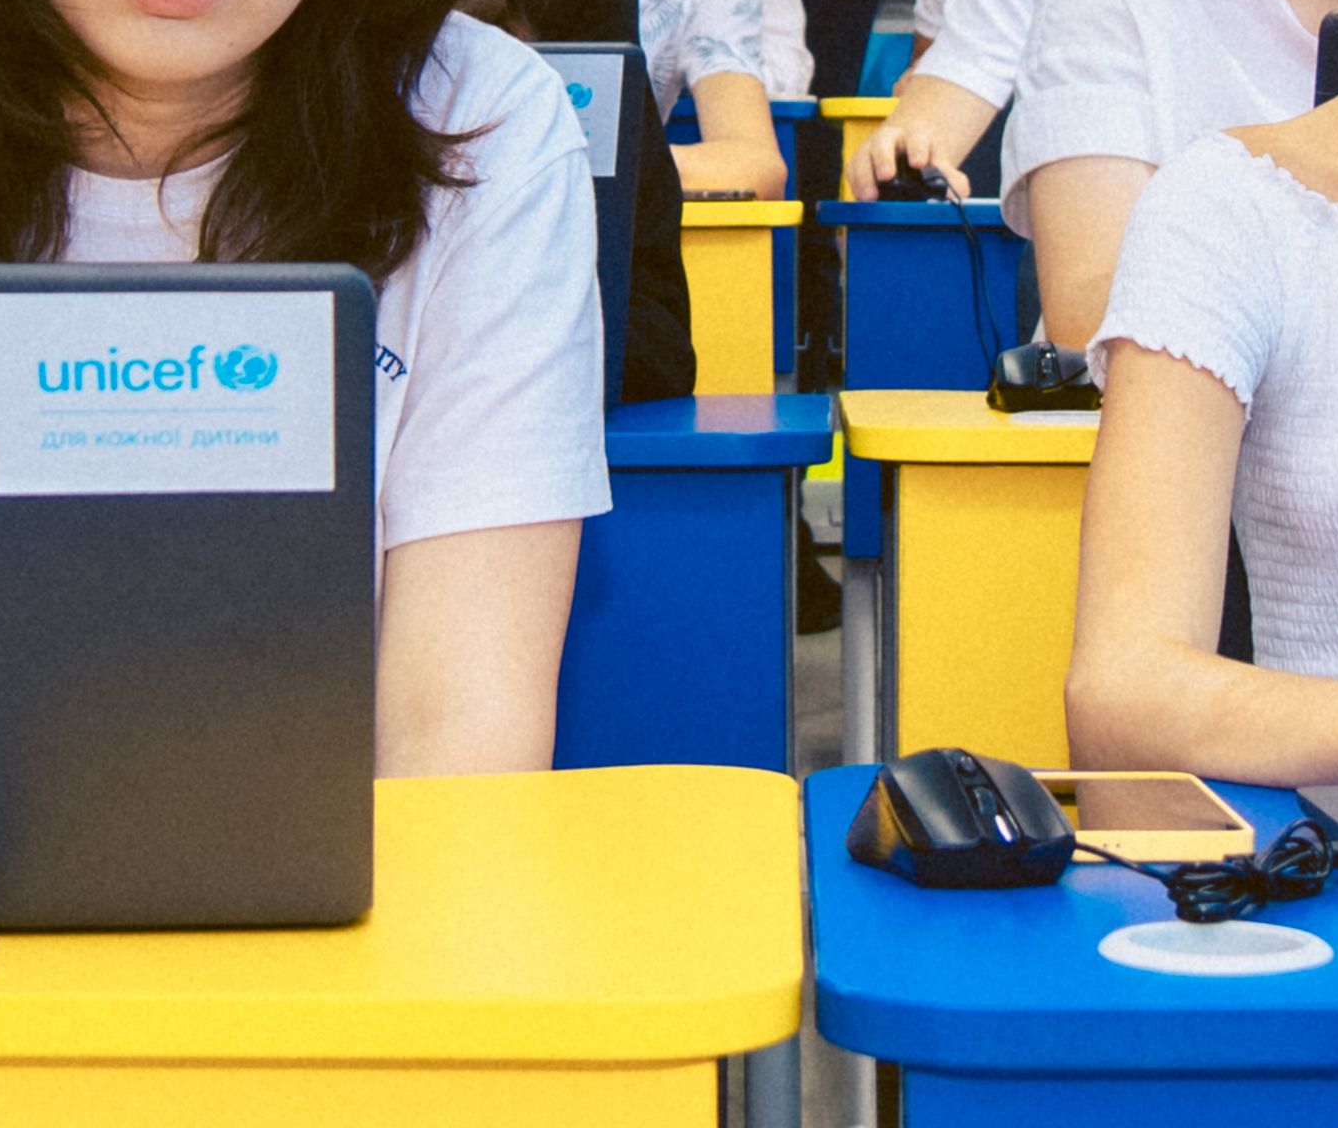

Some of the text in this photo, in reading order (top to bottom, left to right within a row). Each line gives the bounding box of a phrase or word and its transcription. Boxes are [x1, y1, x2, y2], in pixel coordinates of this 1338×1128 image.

[37, 344, 207, 393] unicef
[41, 430, 88, 451] для
[190, 429, 280, 449] дитини
